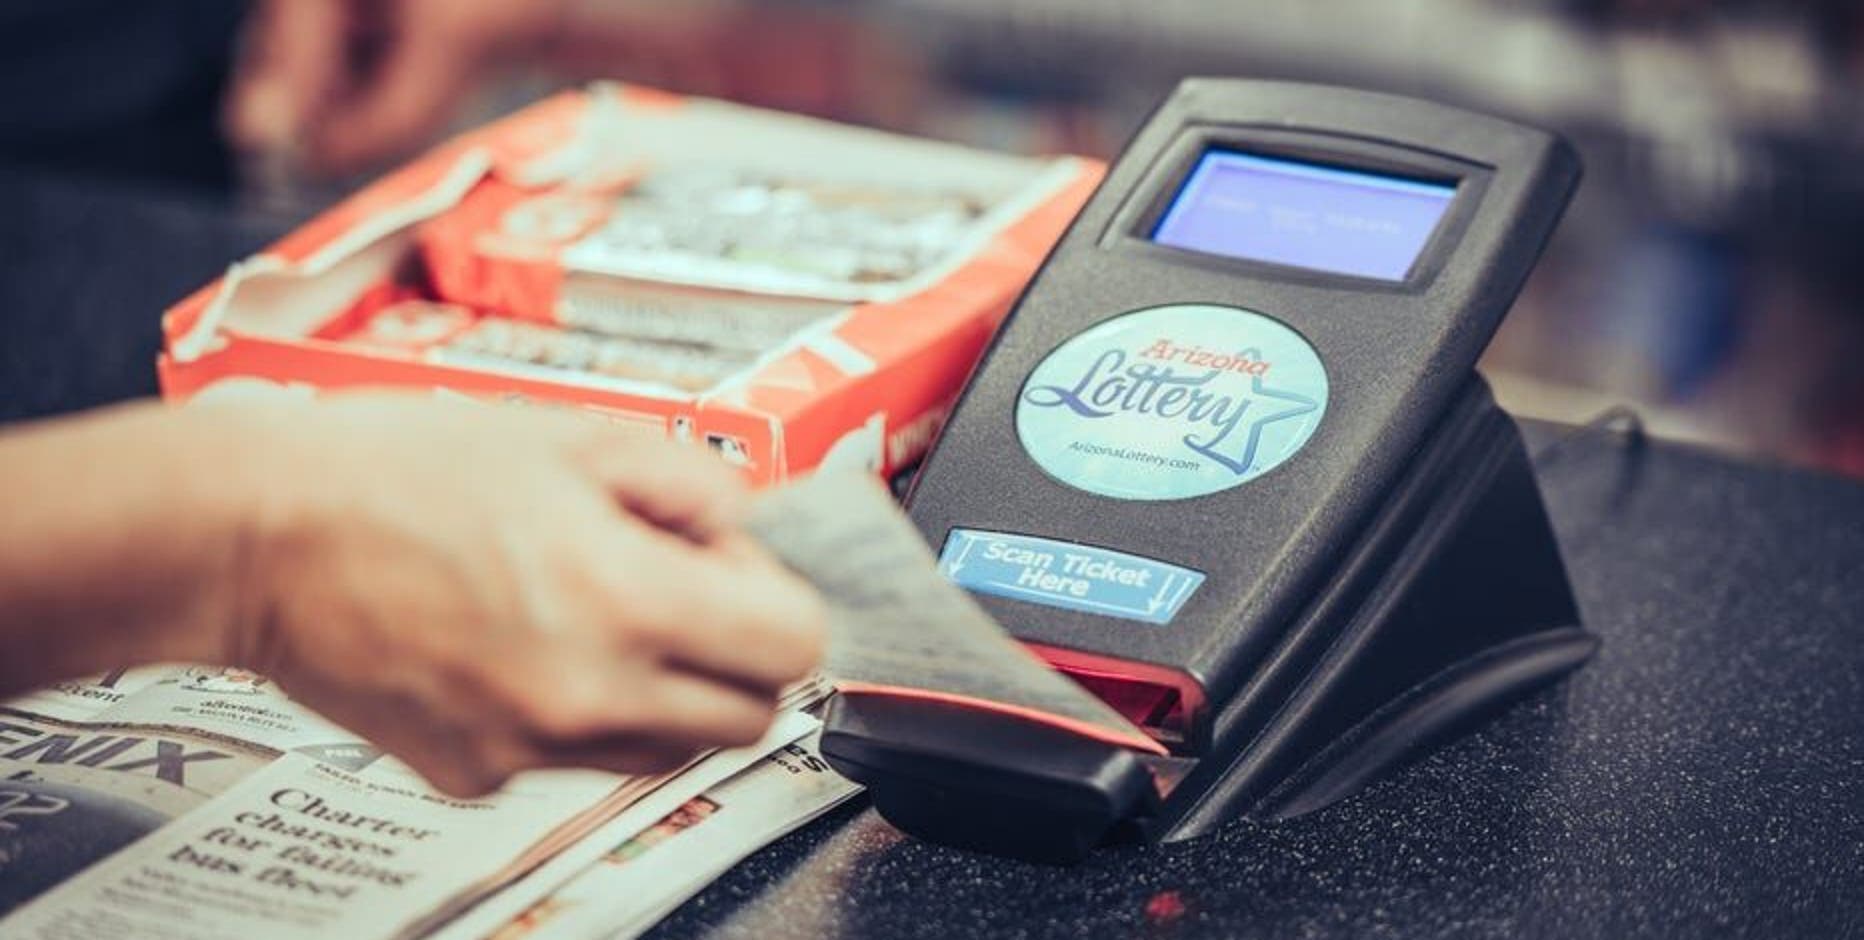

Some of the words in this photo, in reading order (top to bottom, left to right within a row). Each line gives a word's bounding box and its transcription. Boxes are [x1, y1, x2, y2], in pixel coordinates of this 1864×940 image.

[1139, 339, 1272, 377] Arizona
[1024, 349, 1252, 462] Lottery
[1068, 440, 1201, 473] ArizonaLottery.com
[982, 542, 1055, 570] Scan
[1062, 553, 1153, 588] Ticket
[1017, 567, 1090, 597] Here
[269, 788, 441, 840] Charter
[202, 827, 272, 851] for
[168, 844, 242, 874] bus
